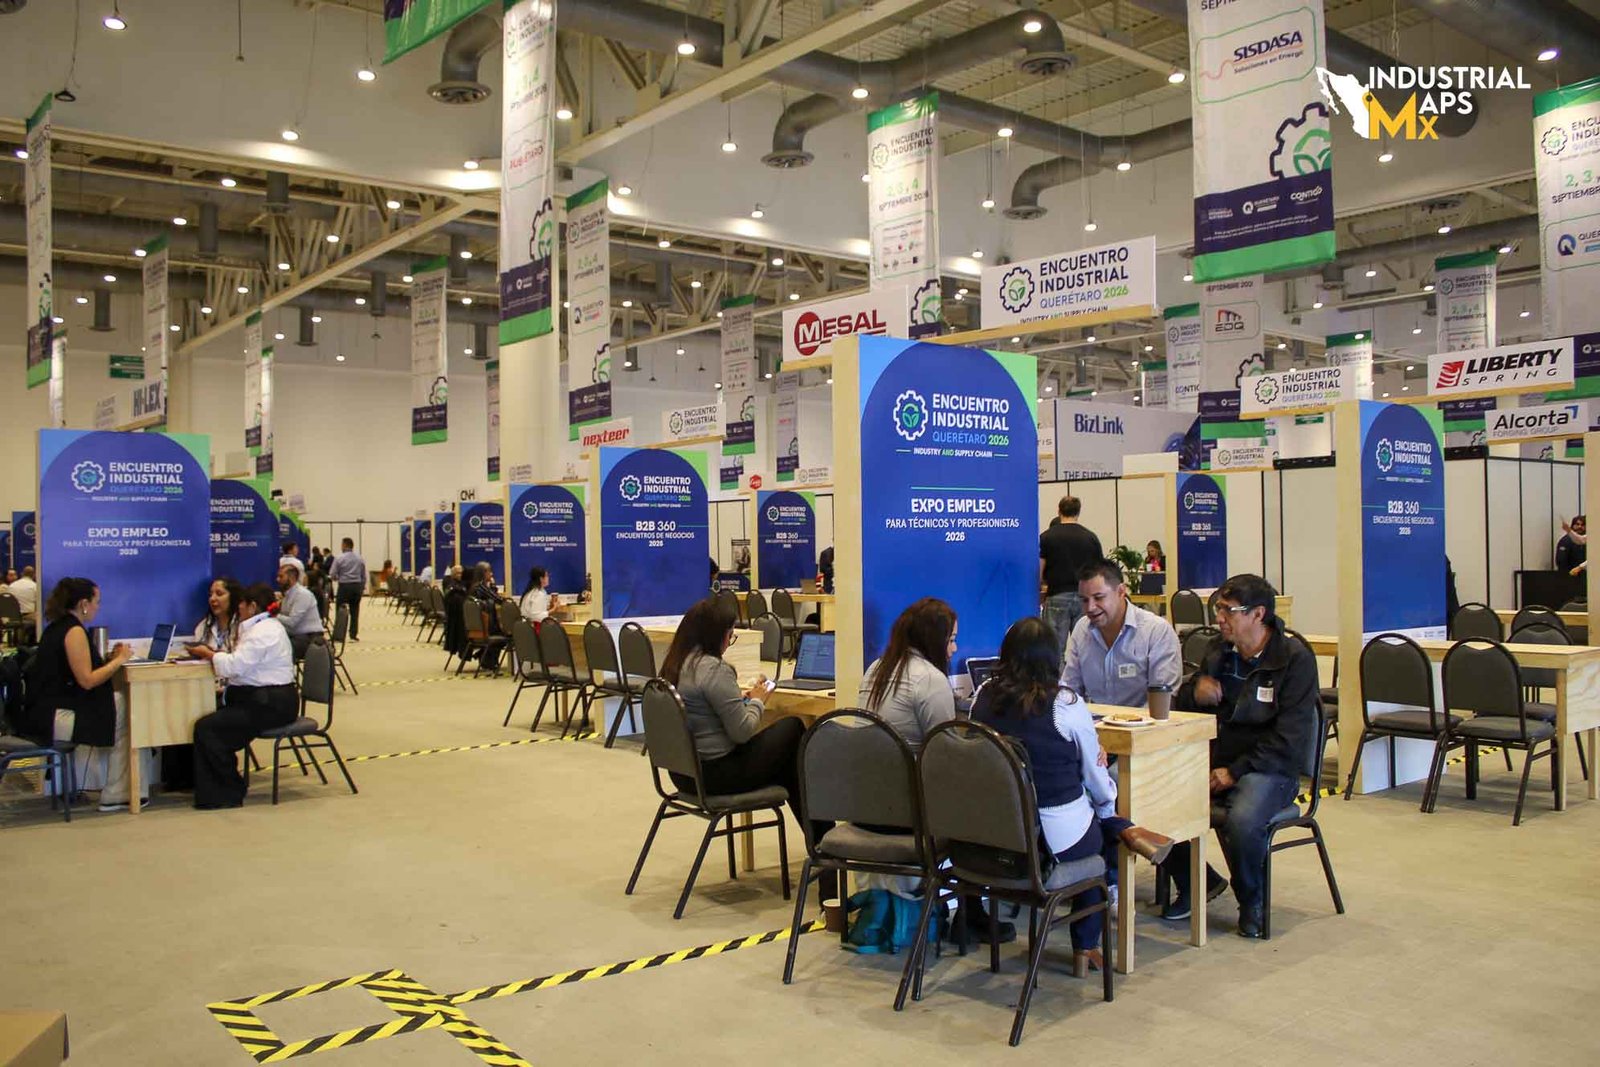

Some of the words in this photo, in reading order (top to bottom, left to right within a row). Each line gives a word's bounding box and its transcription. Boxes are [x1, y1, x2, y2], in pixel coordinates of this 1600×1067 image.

[1234, 31, 1303, 62] SISDASA
[1583, 170, 1593, 183] 3
[1040, 247, 1128, 276] ENCUENTRO
[1040, 265, 1128, 294] INDUSTRIAL
[1040, 288, 1101, 309] QUERÉTARO
[1103, 284, 1129, 299] 2026
[799, 309, 887, 343] MESAL
[1466, 348, 1563, 375] LIBERTY
[1282, 369, 1341, 384] ENCUENTRO
[1462, 368, 1558, 386] SPRING
[1282, 380, 1341, 394] INDUSTRIAL
[932, 393, 1010, 414] ENCUENTRO
[684, 406, 717, 417] ENCUENTRO
[684, 415, 717, 425] INDUSTRIAL
[932, 411, 1010, 431] INDUSTRIAL
[1074, 413, 1124, 435] BizLink
[1494, 410, 1569, 430] Alcorta
[583, 429, 629, 448] nexteer
[932, 431, 987, 445] QUERÉTARO
[988, 434, 1010, 446] 2026
[913, 447, 941, 456] INDUSTRY
[955, 449, 974, 457] SUPPLY
[975, 450, 993, 458] CHAIN
[1394, 440, 1432, 454] ENCUENTRO
[1394, 452, 1432, 465] INDUSTRIAL
[109, 462, 184, 474] ENCUENTRO
[109, 473, 184, 484] INDUSTRIAL
[644, 475, 691, 485] ENCUENTRO
[644, 484, 691, 494] INDUSTRIAL
[210, 498, 255, 506] ENCUENTRO
[911, 498, 944, 513] EXPO
[947, 498, 996, 513] EMPLEO
[1388, 501, 1403, 514] B2B
[1404, 501, 1420, 515] 360
[636, 521, 655, 531] B2B
[657, 521, 676, 531] 360
[886, 518, 907, 528] PARA
[909, 516, 949, 528] TÉCNICOS
[950, 518, 956, 528] Y
[957, 518, 1020, 528] PROFESIONISTAS
[1373, 516, 1404, 525] ENCUENTROS
[88, 527, 120, 538] EXPO
[122, 527, 169, 538] EMPLEO
[223, 533, 240, 541] 360
[945, 531, 966, 542] 2026
[64, 540, 82, 548] PARA
[131, 539, 191, 547] PROFESIONISTAS
